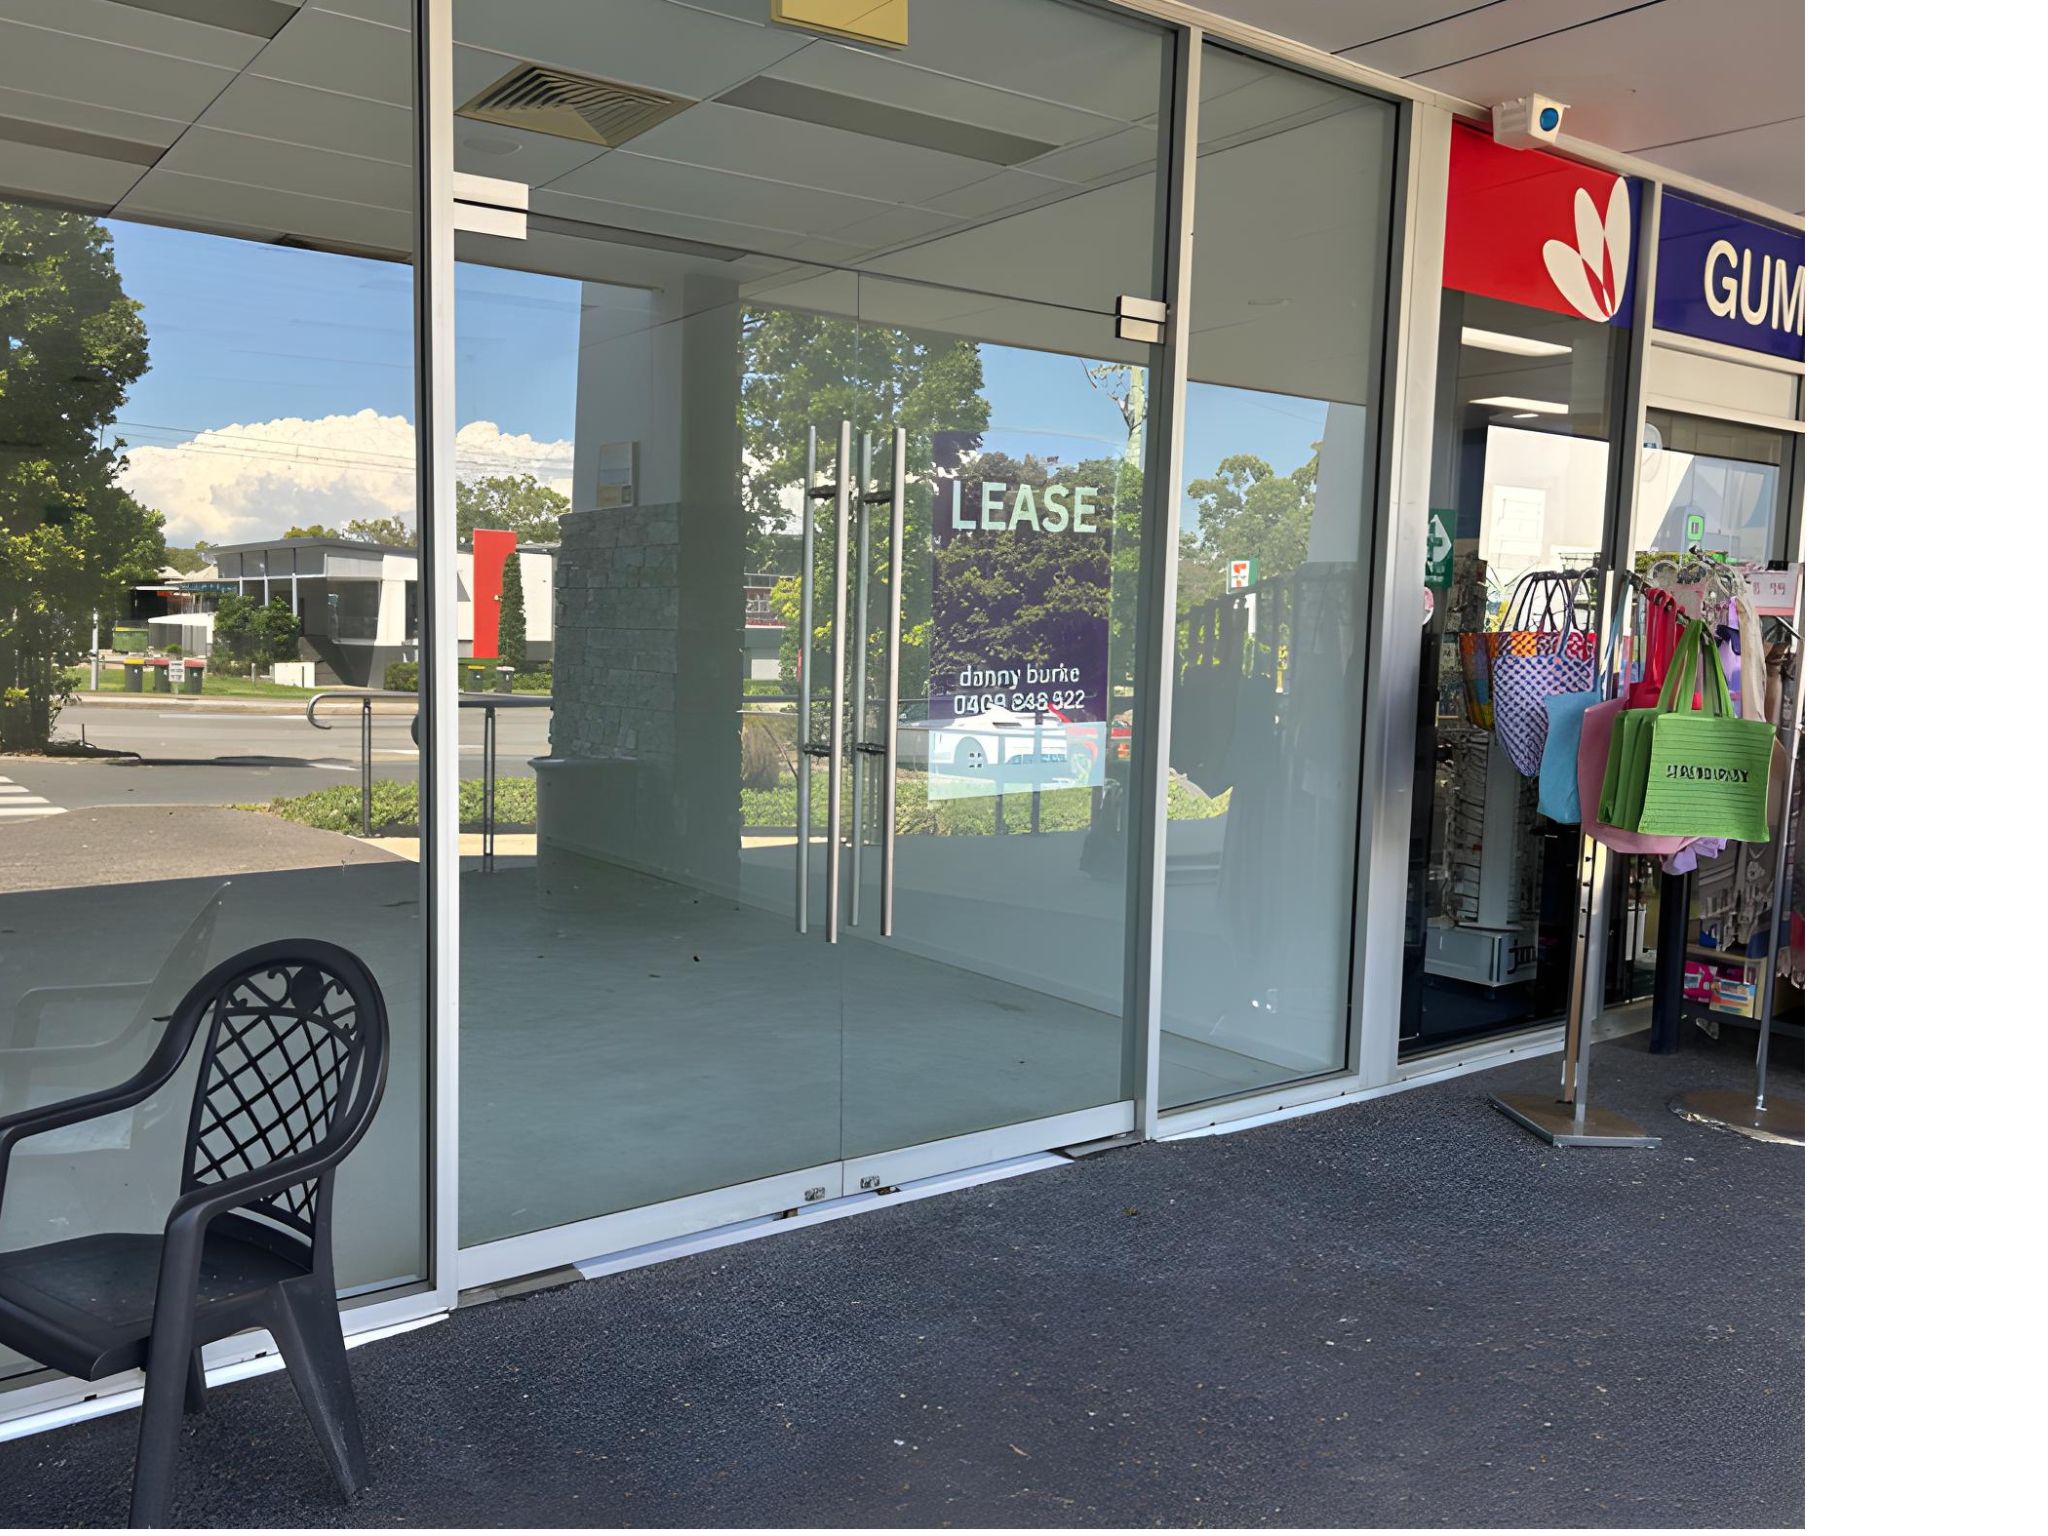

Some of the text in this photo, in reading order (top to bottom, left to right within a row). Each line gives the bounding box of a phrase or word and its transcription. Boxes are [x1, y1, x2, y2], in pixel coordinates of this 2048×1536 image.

[1704, 240, 1804, 336] GUM
[952, 480, 1098, 533] LEASE
[960, 664, 1020, 690] danny
